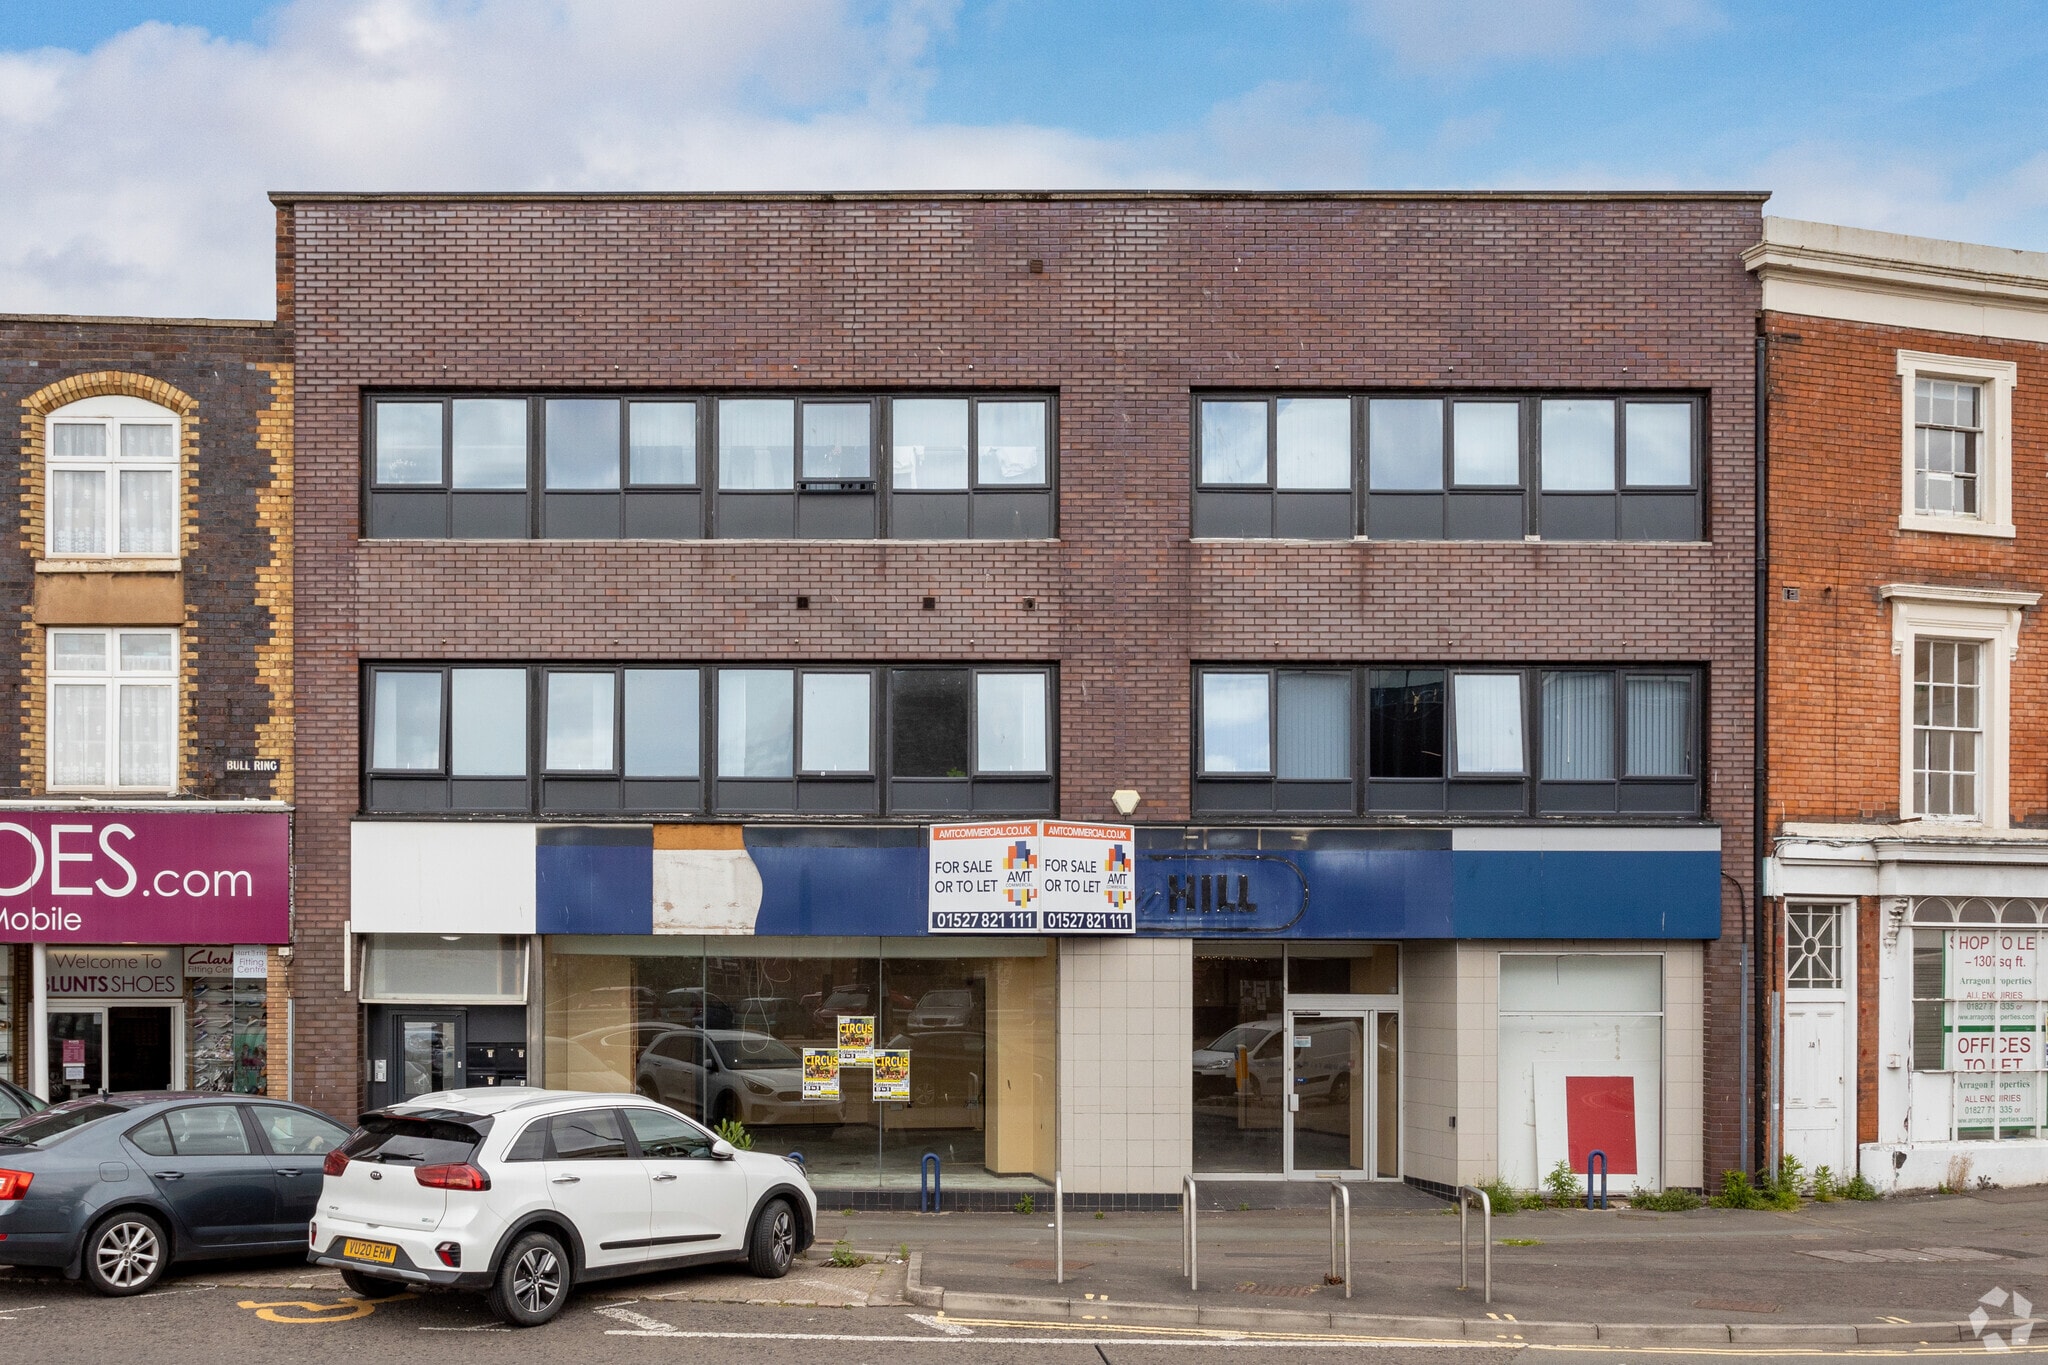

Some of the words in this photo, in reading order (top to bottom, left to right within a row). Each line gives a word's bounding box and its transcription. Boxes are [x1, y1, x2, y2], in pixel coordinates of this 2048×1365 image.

[226, 760, 251, 771] BULL
[254, 760, 278, 771] RING
[938, 825, 1032, 839] AMTCOMMERCIAL.CO.UK
[1048, 826, 1127, 840] AMTCOMMERCIAL.CO.UK
[935, 861, 960, 874] FOR
[963, 860, 993, 873] SALE
[1045, 859, 1068, 872] FOR
[1070, 860, 1097, 873] SALE
[1006, 871, 1032, 883] AMT
[1107, 873, 1127, 885] AMT
[934, 880, 953, 893] OR
[956, 880, 974, 893] TO
[977, 879, 998, 892] LET
[1044, 879, 1062, 892] OR
[1064, 879, 1080, 893] TO
[1083, 880, 1101, 893] LET
[1168, 874, 1258, 914] HILL
[937, 913, 979, 928] 01527
[981, 913, 1005, 928] 821
[1009, 912, 1032, 928] 111
[1047, 912, 1084, 928] 01527
[1086, 913, 1107, 928] 821
[1109, 913, 1128, 929] 111
[2017, 936, 2044, 950] LE
[54, 953, 139, 969] Welcome
[143, 953, 162, 969] To
[239, 958, 264, 967] Fitting
[2000, 958, 2012, 970] sq
[2015, 955, 2026, 967] ft.
[188, 966, 213, 974] Fitting
[237, 965, 266, 973] Centre
[111, 975, 175, 993] SHOES
[1960, 977, 1990, 986] Arragon
[1966, 991, 1980, 999] ALL
[839, 1023, 873, 1034] CIRCUS
[1957, 1037, 2031, 1053] OFFICES
[804, 1055, 838, 1066] CIRCUS
[875, 1056, 908, 1067] CIRCUS
[1964, 1058, 1986, 1074] TO
[1959, 1081, 1988, 1090] Arragon
[1990, 1080, 2031, 1089] Poperties
[1965, 1095, 1978, 1103] ALL
[349, 1241, 372, 1257] VU20
[373, 1245, 393, 1260] EHW
